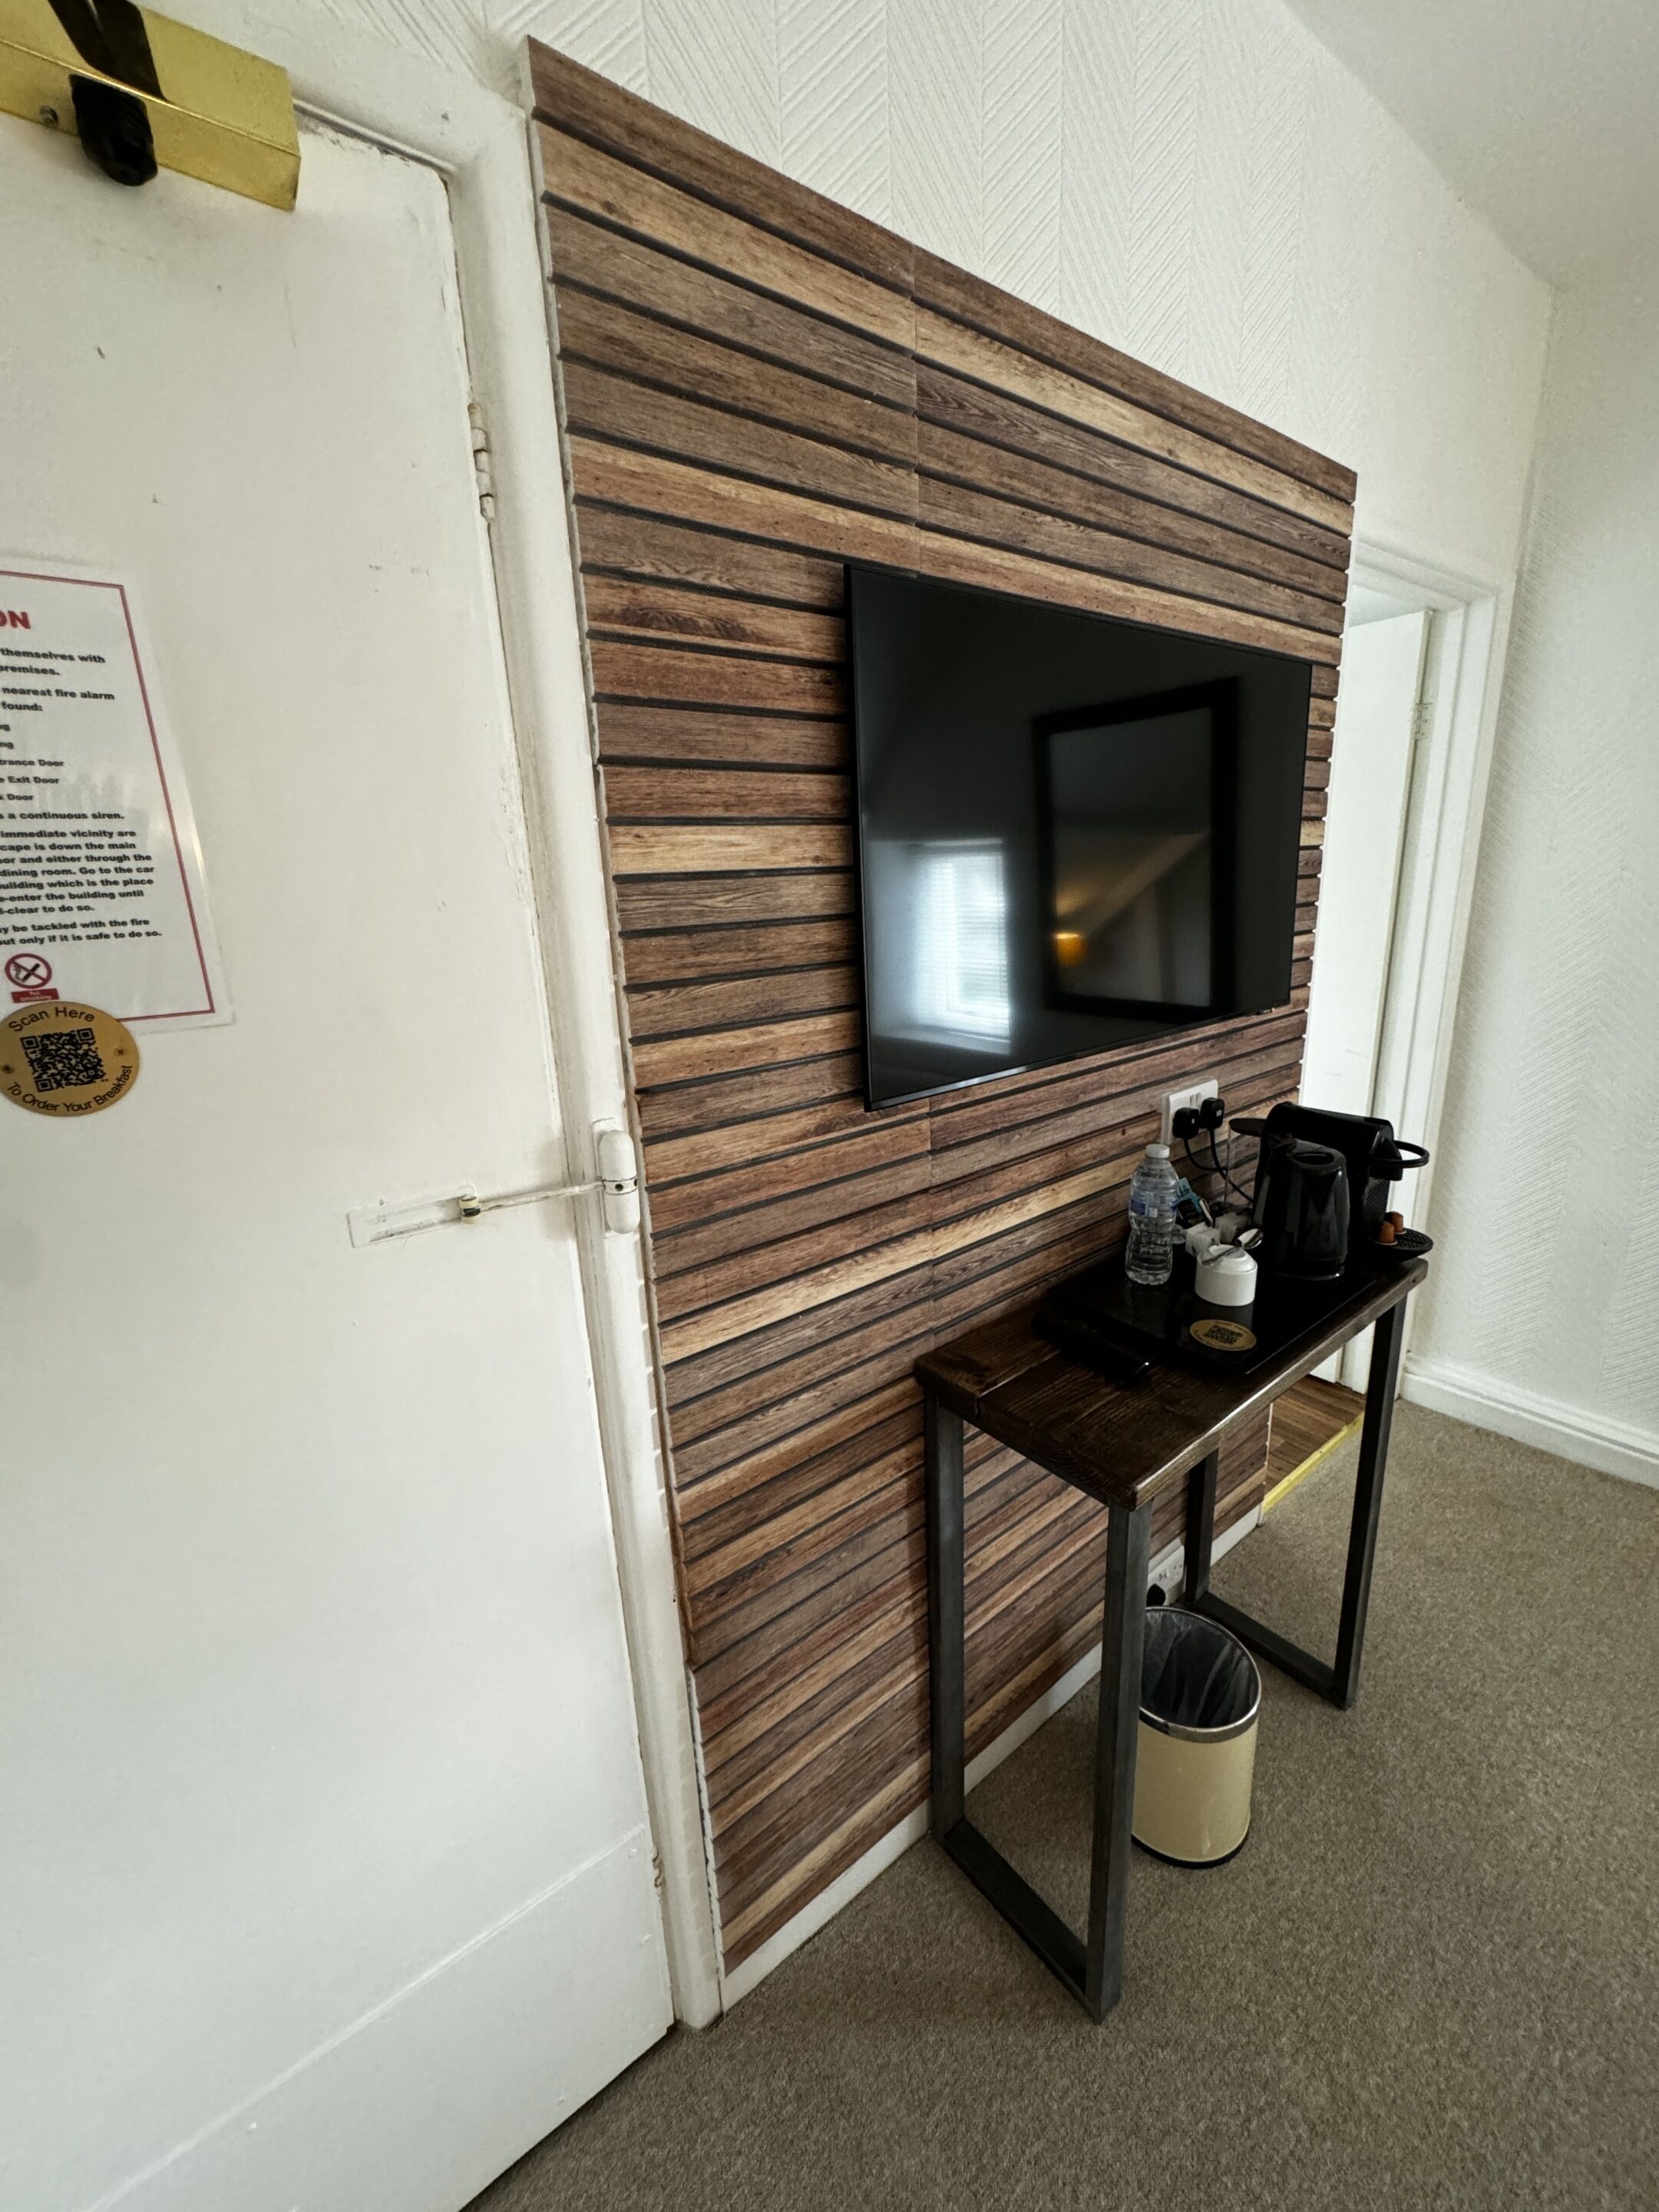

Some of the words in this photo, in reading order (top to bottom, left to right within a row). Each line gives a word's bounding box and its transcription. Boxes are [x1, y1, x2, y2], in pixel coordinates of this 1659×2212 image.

[78, 654, 106, 663] with
[2, 687, 53, 696] nearest
[55, 689, 77, 698] fire
[80, 690, 115, 700] alarm
[1, 701, 43, 711] found:
[70, 830, 114, 838] vicinity
[84, 855, 131, 863] through
[123, 878, 154, 887] place
[68, 891, 116, 900] building
[31, 922, 77, 931] tackled
[8, 1010, 50, 1032] Scan
[55, 1007, 95, 1023] Here
[7, 1081, 22, 1096] To
[22, 1093, 61, 1112] Order
[62, 1100, 93, 1113] Your
[93, 1065, 133, 1106] Breakfast
